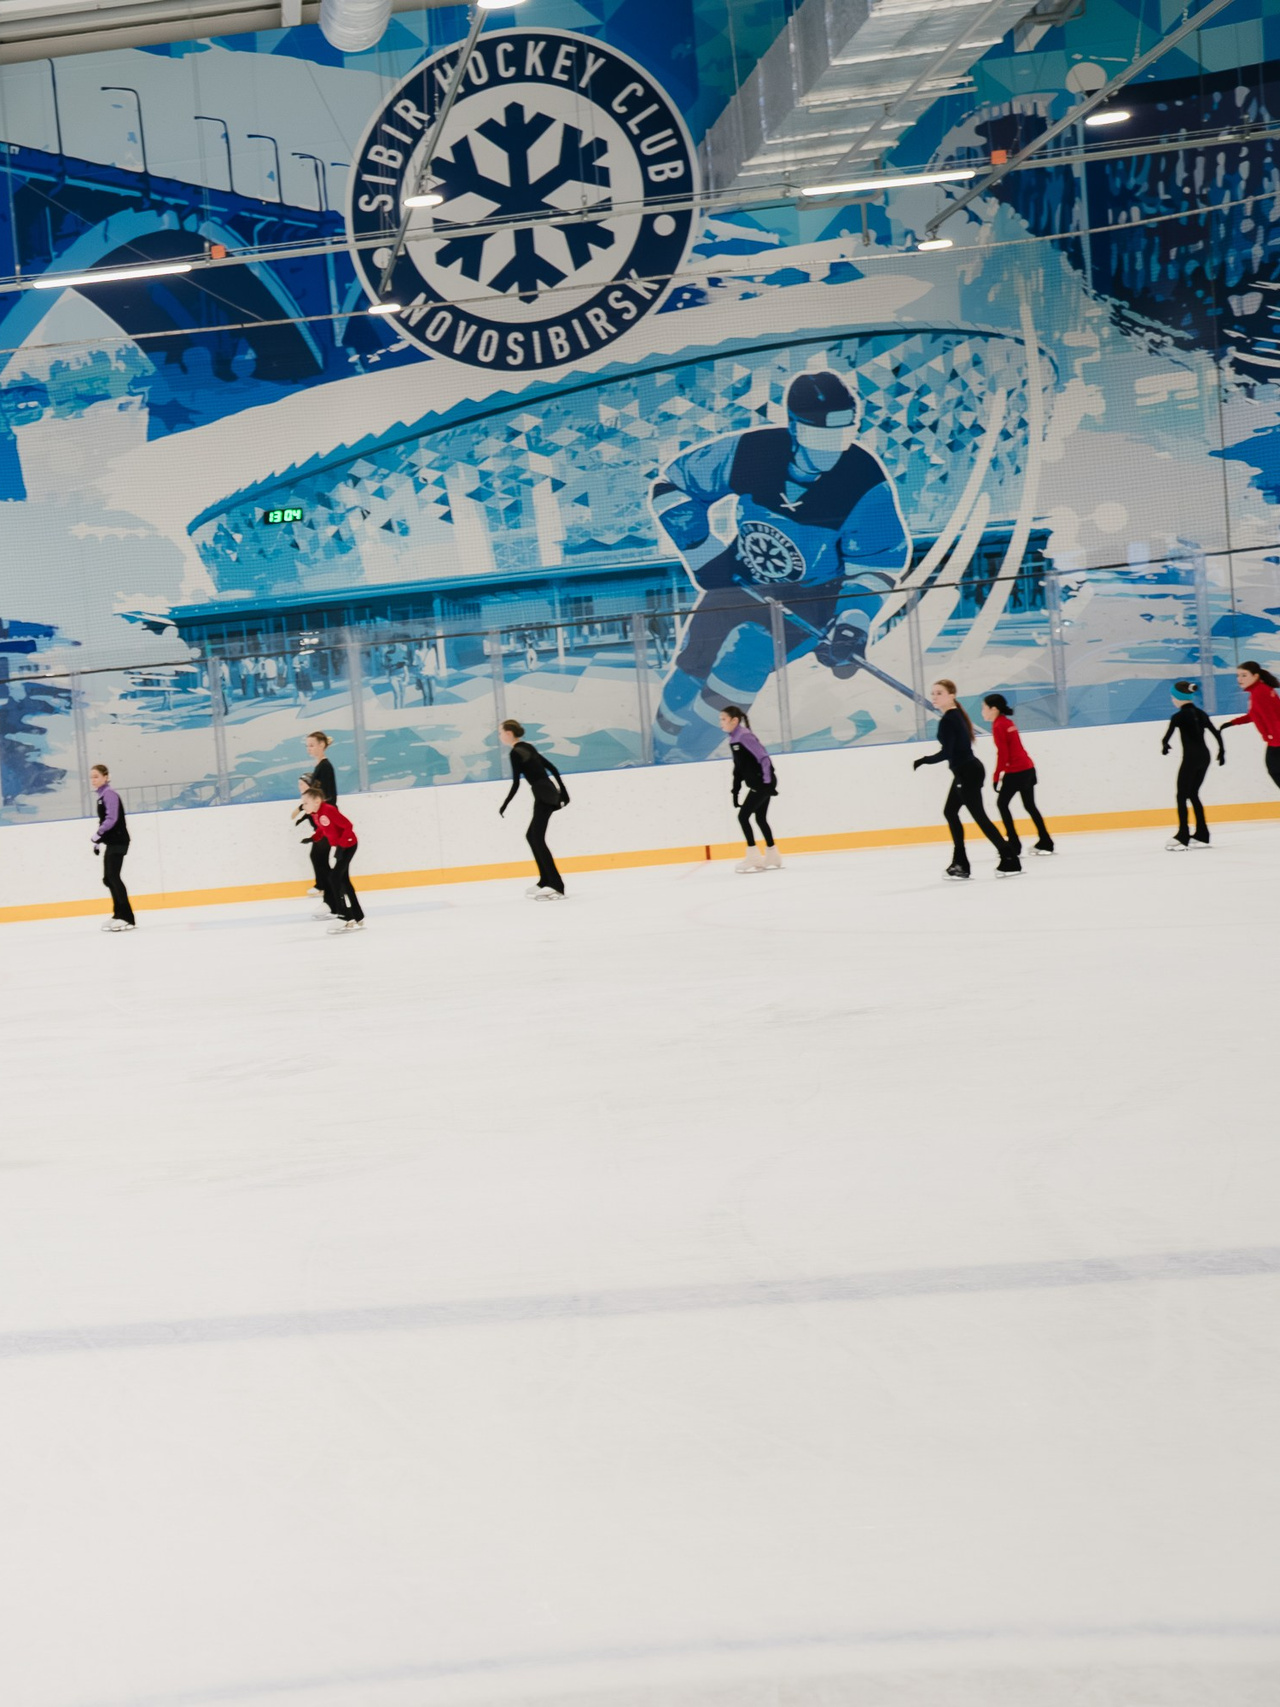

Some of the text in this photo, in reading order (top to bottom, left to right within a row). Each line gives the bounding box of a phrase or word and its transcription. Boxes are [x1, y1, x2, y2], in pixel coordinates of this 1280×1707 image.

[358, 40, 685, 213] SIBIR HOCKEY CLUB
[400, 267, 660, 366] NOVOSIBIRSK
